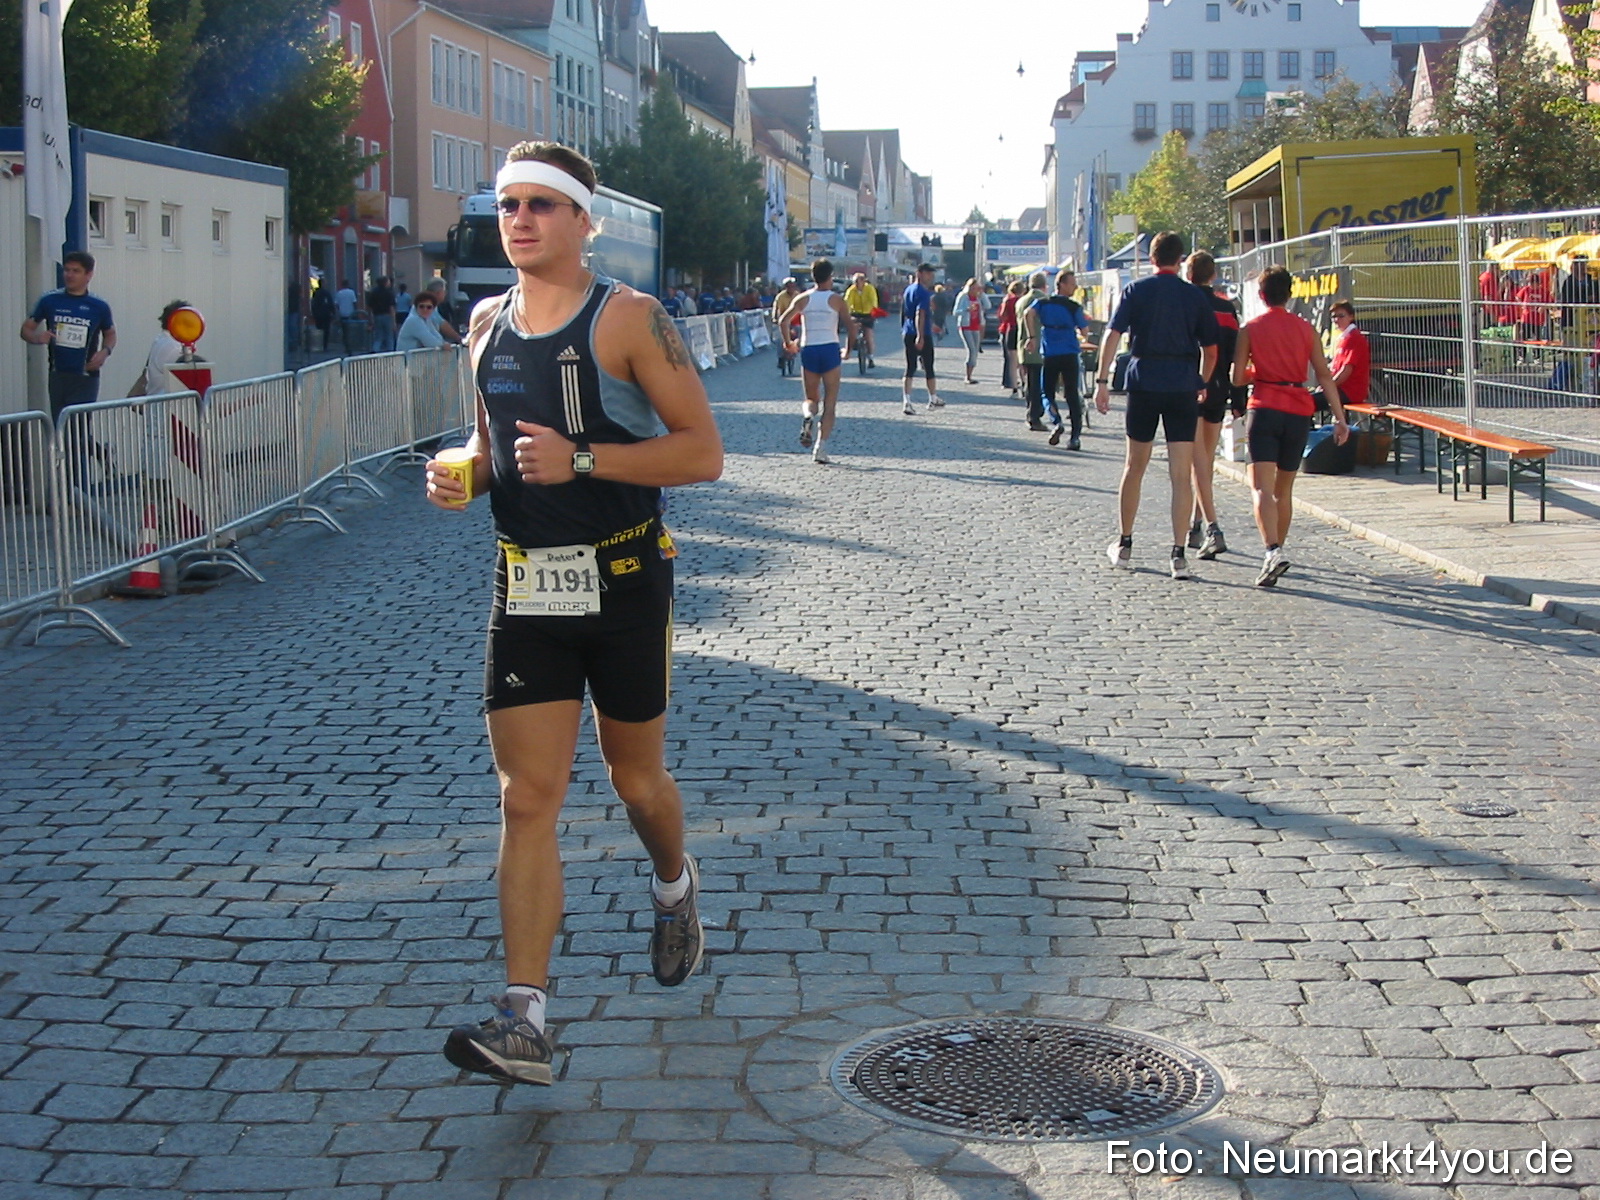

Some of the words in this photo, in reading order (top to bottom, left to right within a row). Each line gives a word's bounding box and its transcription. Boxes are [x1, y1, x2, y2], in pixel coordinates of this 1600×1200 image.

[1309, 184, 1454, 246] Glossner
[999, 247, 1046, 256] PFLEIDERER
[67, 332, 82, 342] 734
[547, 552, 577, 563] Peter
[514, 565, 525, 582] D
[535, 568, 594, 593] 1191
